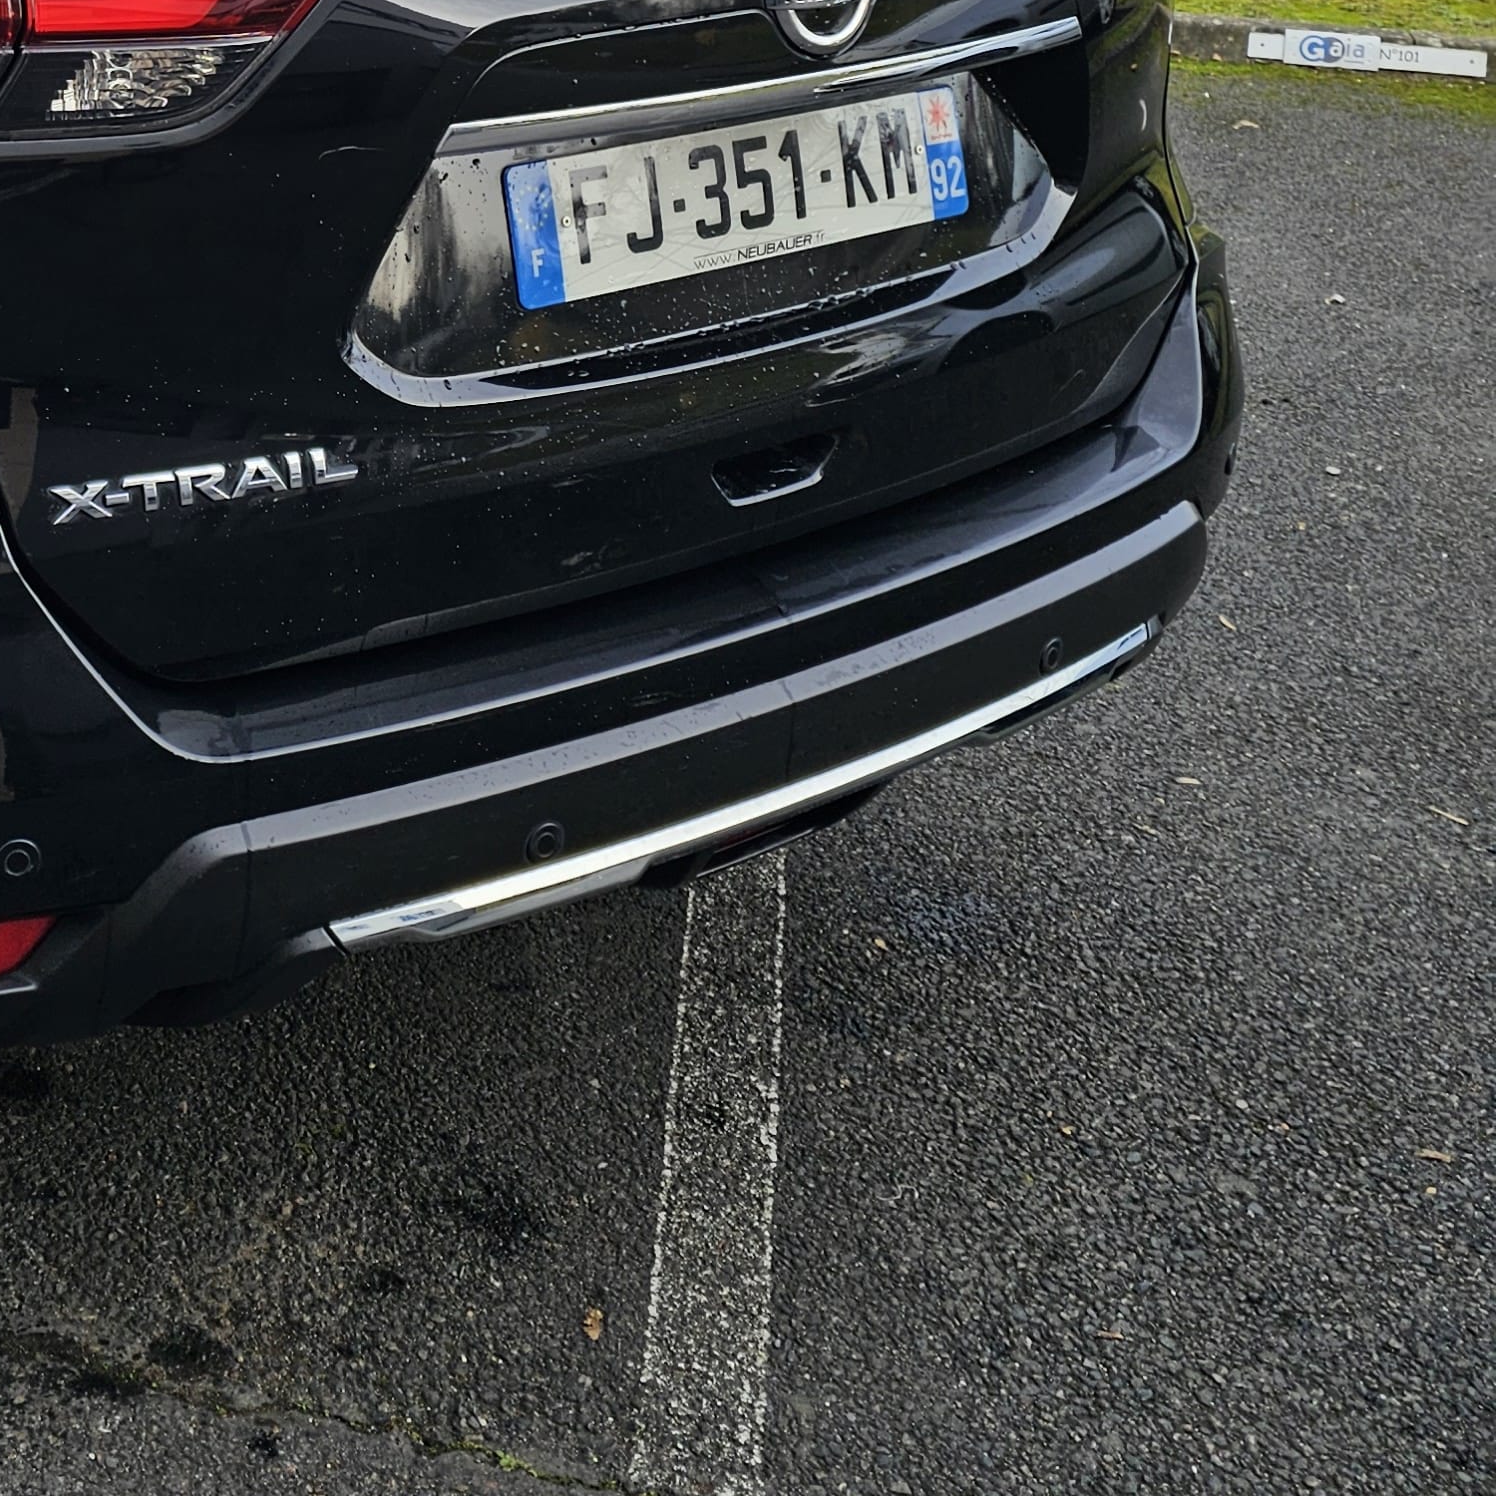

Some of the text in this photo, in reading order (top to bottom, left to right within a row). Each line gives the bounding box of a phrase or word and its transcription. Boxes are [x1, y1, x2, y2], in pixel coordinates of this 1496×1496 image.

[1300, 36, 1365, 61] Gaia
[568, 108, 917, 264] FJ-351-KM
[931, 155, 965, 201] 92
[531, 247, 545, 278] F
[49, 448, 359, 525] X-TRAIL
